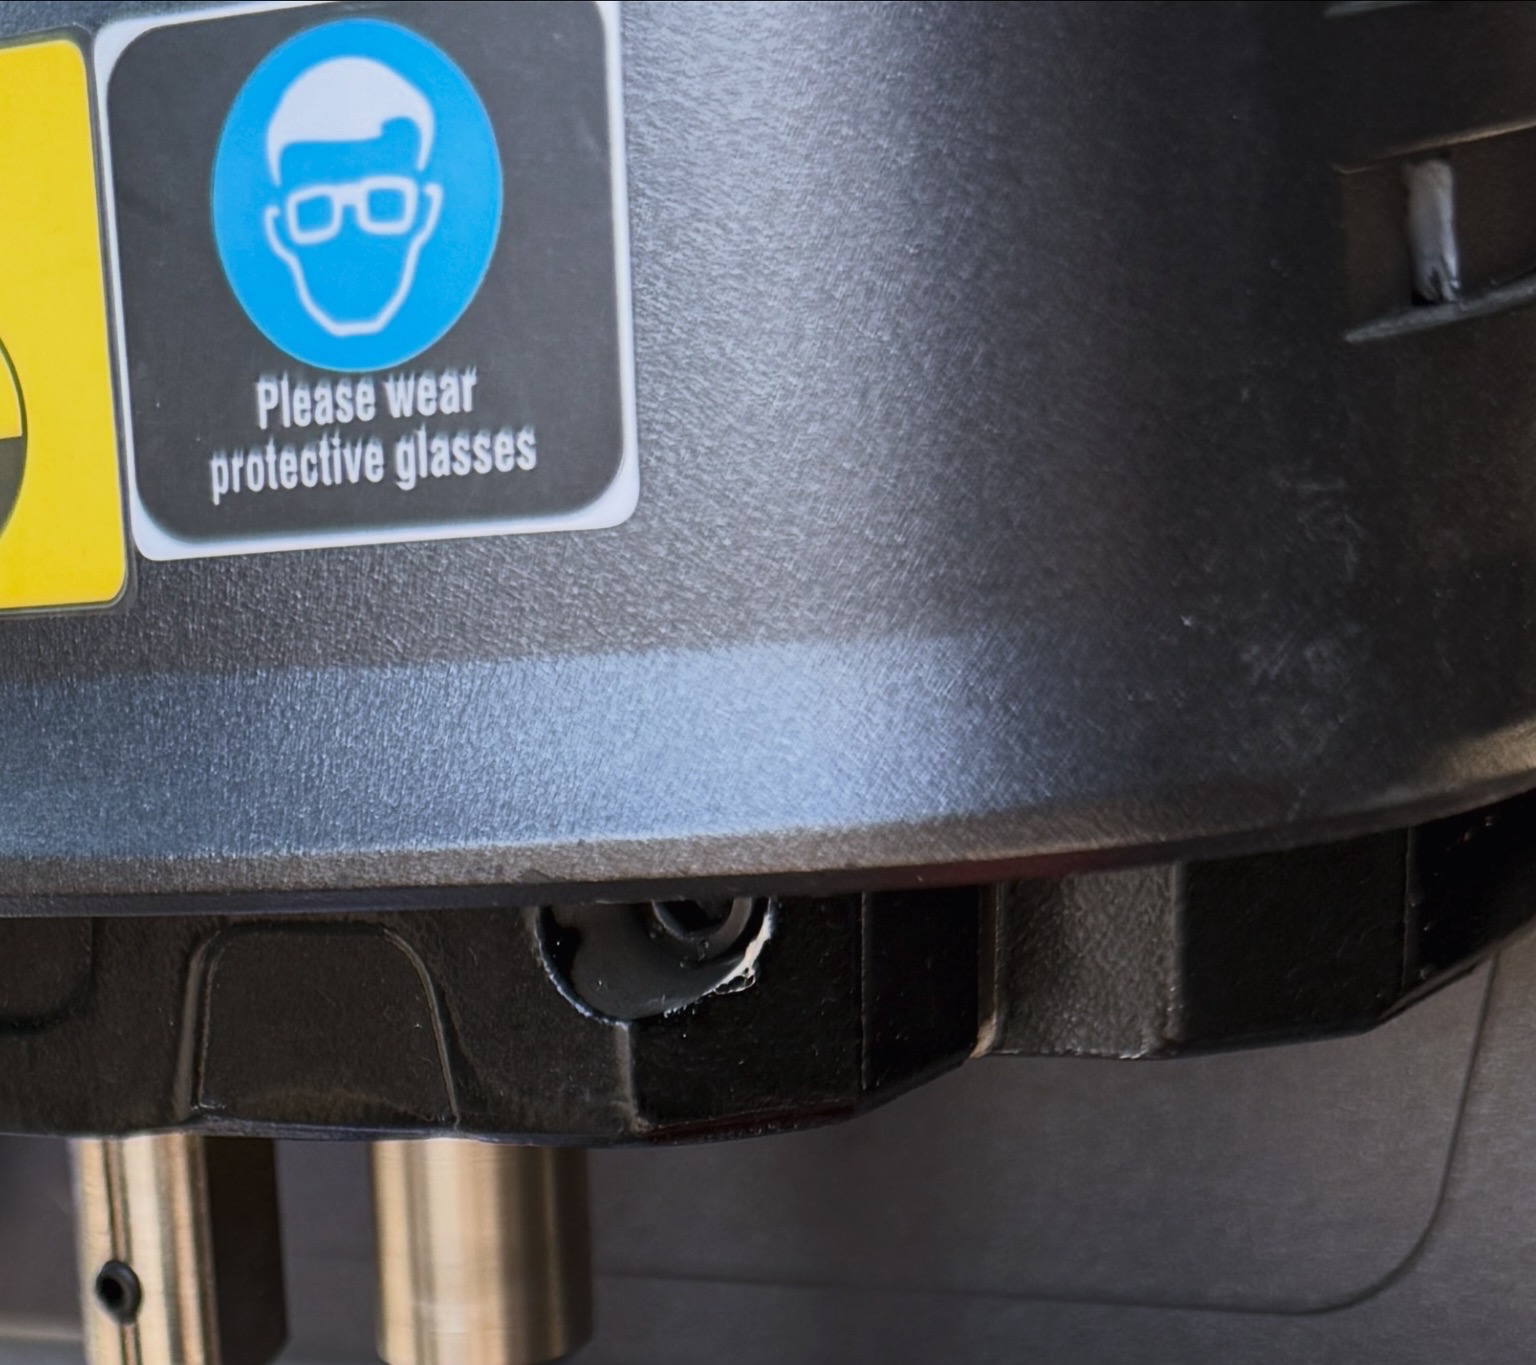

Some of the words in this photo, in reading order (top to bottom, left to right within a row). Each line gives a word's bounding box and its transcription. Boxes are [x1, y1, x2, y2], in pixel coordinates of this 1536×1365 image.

[254, 370, 376, 430] Please
[384, 367, 477, 419] wear
[209, 430, 384, 506] protective
[395, 423, 537, 491] glasses
